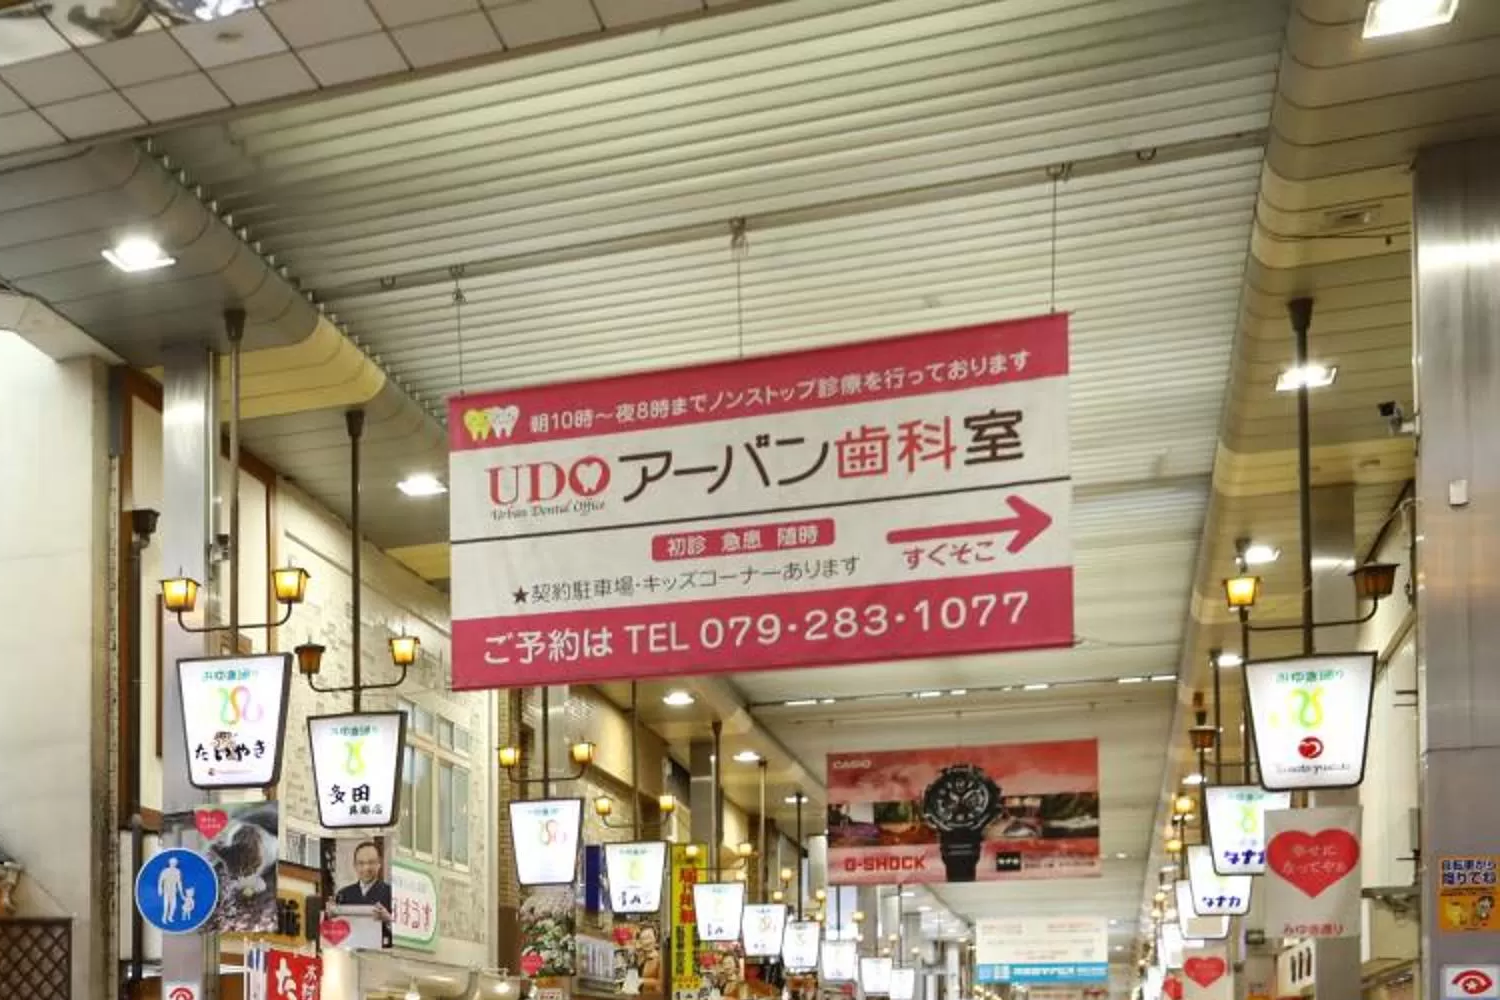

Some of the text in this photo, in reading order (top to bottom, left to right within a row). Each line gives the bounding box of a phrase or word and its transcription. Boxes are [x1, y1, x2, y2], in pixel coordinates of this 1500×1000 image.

[618, 409, 1025, 503] アーバン歯科室
[486, 455, 611, 506] UDO
[667, 535, 707, 557] 初診
[776, 524, 819, 546] 随時
[484, 624, 613, 665] ご予約は
[624, 621, 690, 654] TEL
[195, 740, 266, 762] たいやき
[832, 759, 873, 770] CASIO
[843, 855, 926, 873] G-SHOCK
